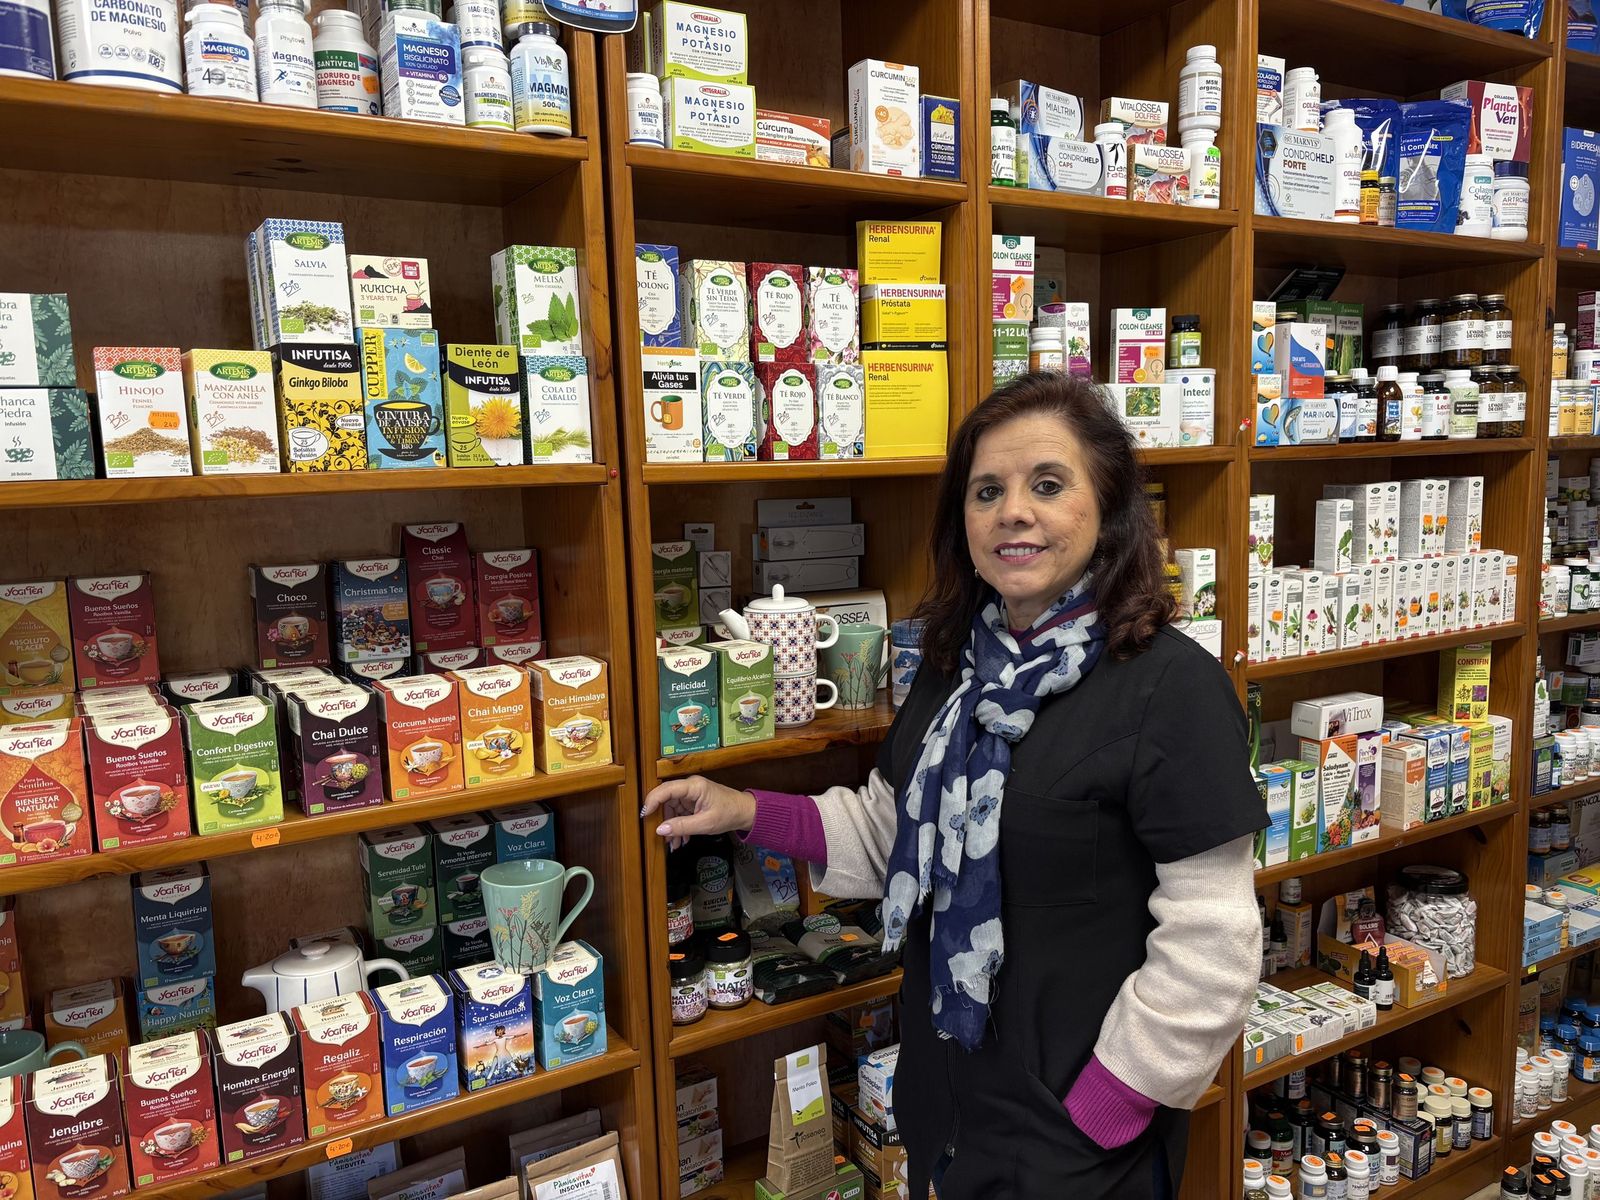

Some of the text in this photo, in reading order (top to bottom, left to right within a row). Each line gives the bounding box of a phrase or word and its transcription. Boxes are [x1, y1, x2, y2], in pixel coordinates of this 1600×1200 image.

[94, 0, 162, 19] CARBONATO
[91, 11, 167, 33] DE MAGNESIO
[676, 22, 736, 39] MAGNESIO
[202, 42, 246, 57] MAGNESIO
[403, 43, 449, 57] MAGNESIO
[682, 38, 732, 53] POTASIO
[317, 61, 356, 70] SANTIVERI
[403, 53, 450, 66] BISGLICINATO
[316, 72, 348, 81] CLORURO
[317, 79, 355, 88] MAGNESIO
[530, 82, 569, 97] MAGMAX
[684, 96, 745, 111] MAGNESIO
[1119, 101, 1162, 113] VITALOSSEA
[1483, 97, 1517, 113] Planta
[1045, 104, 1076, 117] MIALTRIM
[1134, 112, 1161, 121] DOLFREE
[690, 111, 740, 125] POTASIO
[1496, 111, 1516, 125] Ven
[757, 121, 794, 135] Cúrcuma
[1058, 152, 1099, 164] CONDROHELP
[1143, 148, 1184, 160] VITALOSSEA
[1283, 147, 1335, 164] CONDROHELP
[1283, 159, 1307, 170] FORTE
[869, 224, 935, 235] HERBENSURINA
[291, 237, 324, 245] ARTEMIS
[1010, 253, 1032, 261] CLEANSE
[294, 259, 327, 269] SALVIA
[534, 275, 564, 284] MELISA
[360, 283, 408, 294] KUKICHA
[880, 288, 943, 298] HERBENSURINA
[765, 291, 794, 300] TÉ ROJO
[822, 302, 848, 310] MATCHA
[881, 299, 911, 308] Próstata
[292, 349, 351, 361] INFUTISA
[455, 347, 510, 357] Diente de
[366, 333, 380, 397] CUPPER
[472, 358, 498, 369] León
[868, 363, 933, 372] HERBENSURINA
[465, 376, 511, 386] INFUTISA
[868, 373, 889, 381] Renal
[204, 383, 266, 393] MANZANILLA
[289, 377, 348, 390] Ginkgo Biloba
[658, 380, 684, 389] Gases
[119, 386, 164, 396] HINOJO
[1183, 387, 1211, 397] Intecol
[376, 410, 430, 421] CINTURA
[379, 419, 430, 428] DE AVISPA
[422, 546, 451, 555] Classic
[484, 571, 532, 581] Energía Positiva
[344, 585, 403, 597] Christmas Tea
[277, 593, 307, 603] Choco
[84, 602, 139, 612] Buenos Sueños
[9, 637, 50, 646] ABSOLUTO
[1457, 658, 1489, 666] CONSTIFIN
[726, 673, 771, 685] Equilibrio Alcalino
[671, 680, 706, 691] Felicidad
[548, 692, 605, 706] Chai Himalaya
[468, 703, 524, 717] Chai Mango
[392, 714, 456, 729] Cúrcuma Naranja
[312, 725, 369, 741] Chai Dulce
[197, 739, 274, 757] Confort Digestivo
[1474, 744, 1492, 754] CONSTIFIN
[106, 749, 167, 764] Buenos Sueños
[18, 780, 53, 789] Sentidos
[15, 795, 59, 806] BIENESTAR
[18, 803, 58, 813] NATURAL
[508, 839, 545, 852] Voz Clara
[377, 863, 426, 878] Serenidad Tulsi
[140, 905, 207, 924] Menta Liquirizia
[459, 942, 488, 953] Harmonia
[555, 987, 594, 1004] Voz Clara
[146, 1007, 210, 1028] Happy Nature
[472, 1005, 526, 1024] Star Salutation
[98, 1028, 123, 1040] Limón
[394, 1025, 447, 1046] Respiración
[323, 1048, 361, 1064] Regaliz
[223, 1067, 296, 1092] Hombre Energía
[140, 1088, 198, 1108] Buenos Sueños
[49, 1118, 103, 1139] Jengibre
[560, 1180, 590, 1194] INSOVITA
